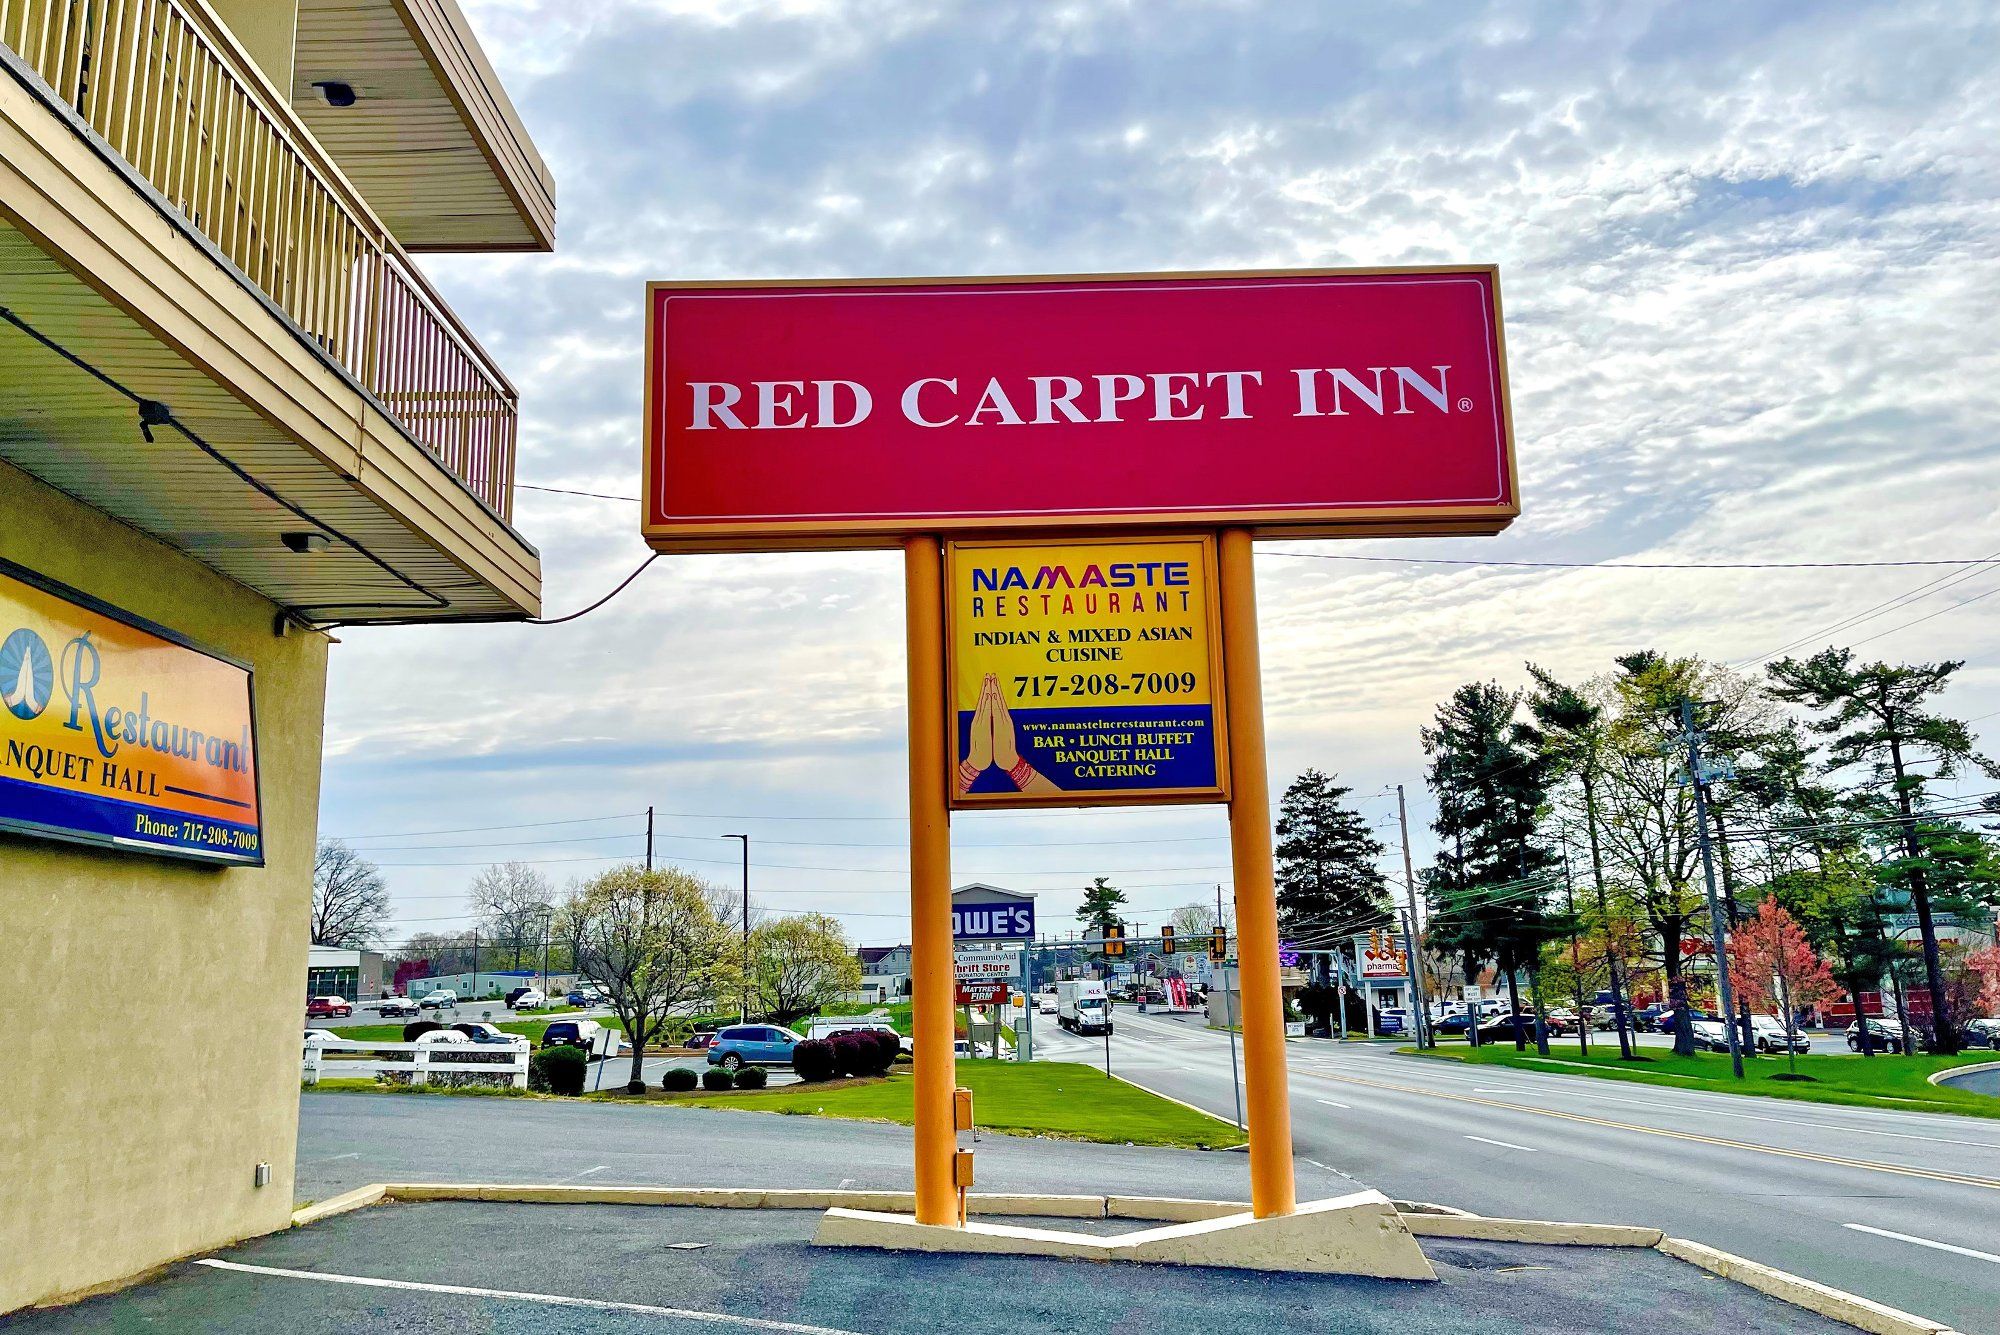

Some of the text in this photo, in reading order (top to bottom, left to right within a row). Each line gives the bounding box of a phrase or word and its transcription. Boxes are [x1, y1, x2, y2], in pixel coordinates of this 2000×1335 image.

[685, 380, 873, 430] RED
[900, 371, 1262, 428] CARPET
[1290, 365, 1452, 417] INN
[972, 562, 1189, 591] NAMASTE
[973, 591, 1190, 618] RESTAURANT
[974, 626, 1193, 646] INDIAN & MIXED ASIAN
[1046, 647, 1123, 662] CUISINE
[1013, 672, 1196, 698] 717-208-7009
[60, 629, 249, 774] Restaurant
[1033, 732, 1195, 748] BAR LUNCH BUFFET
[1055, 748, 1175, 764] BANQUET HALL
[0, 739, 160, 797] NQUET HALL
[1074, 763, 1156, 778] CATERING
[135, 814, 258, 850] Phone: 717-208-7009
[952, 906, 1031, 935] OWE'S
[958, 952, 1017, 962] CommunityAid
[1367, 962, 1398, 972] pharma
[954, 963, 1010, 973] hrift Store
[970, 992, 994, 1000] FIRM
